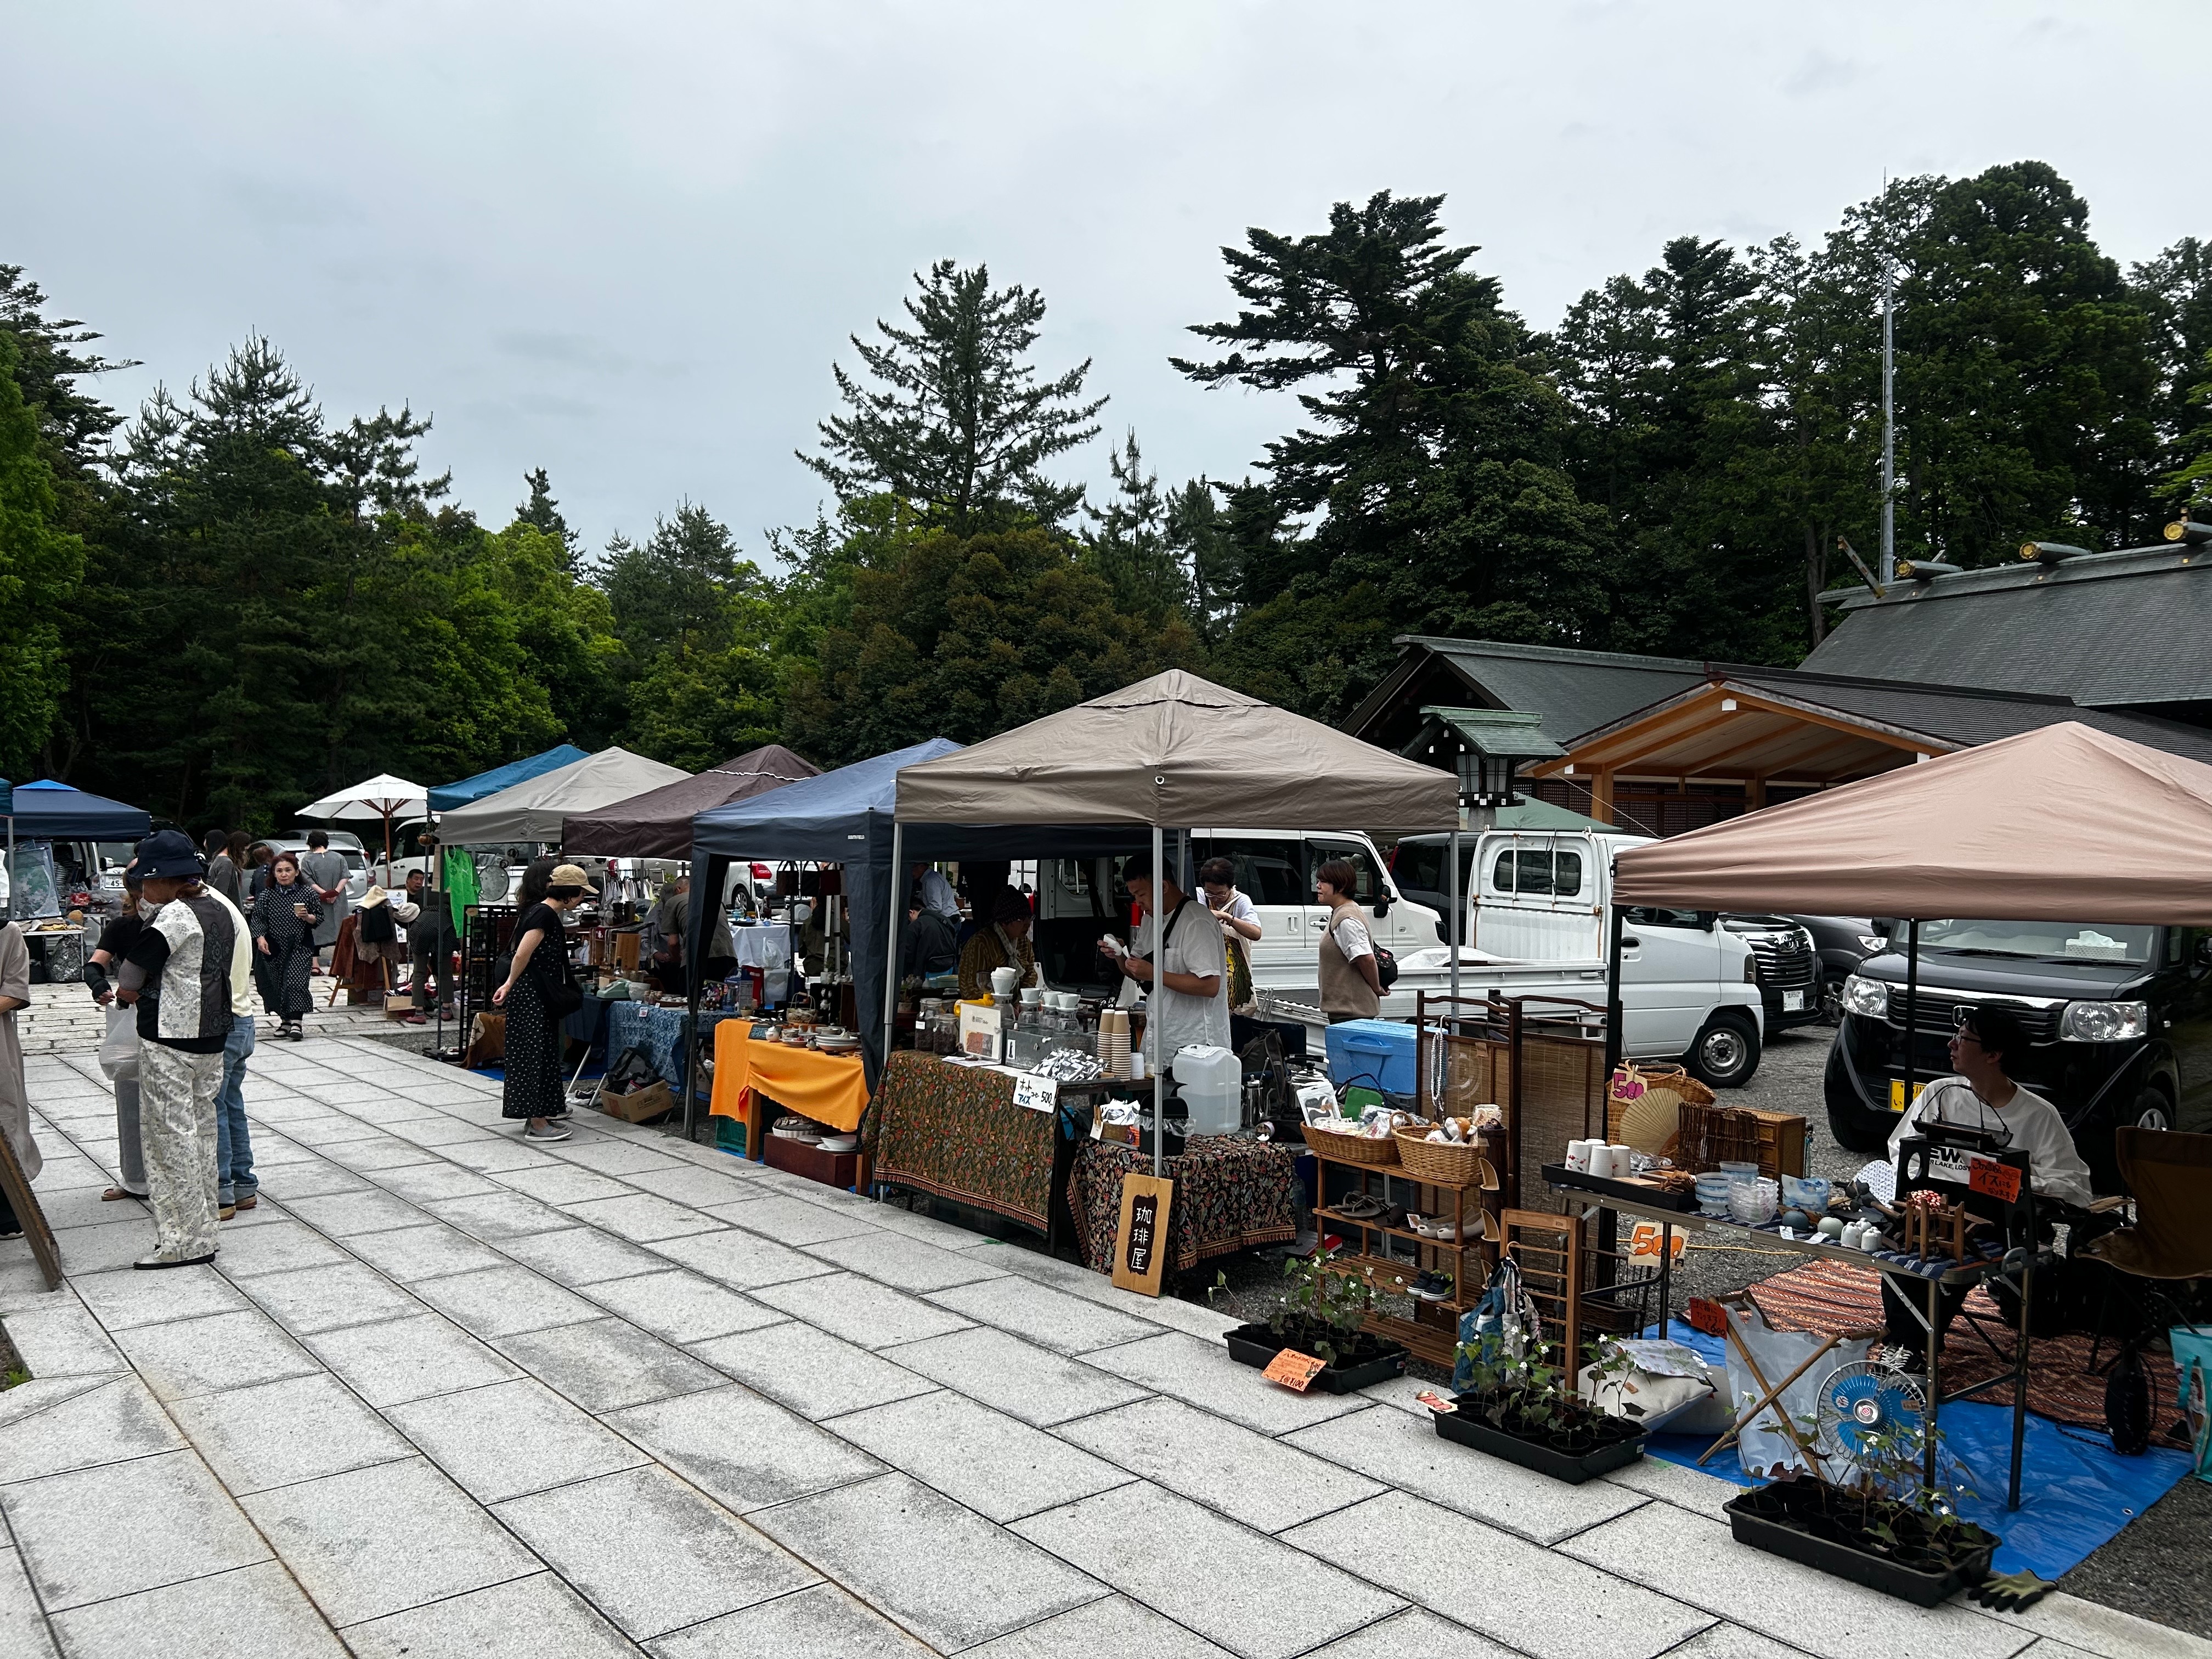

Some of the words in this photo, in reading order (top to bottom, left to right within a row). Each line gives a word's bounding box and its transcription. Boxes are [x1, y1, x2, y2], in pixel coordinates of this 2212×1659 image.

[1020, 1078, 1032, 1092] ホット
[1018, 1093, 1031, 1105] アイス
[1131, 1206, 1153, 1269] 珈琲屋
